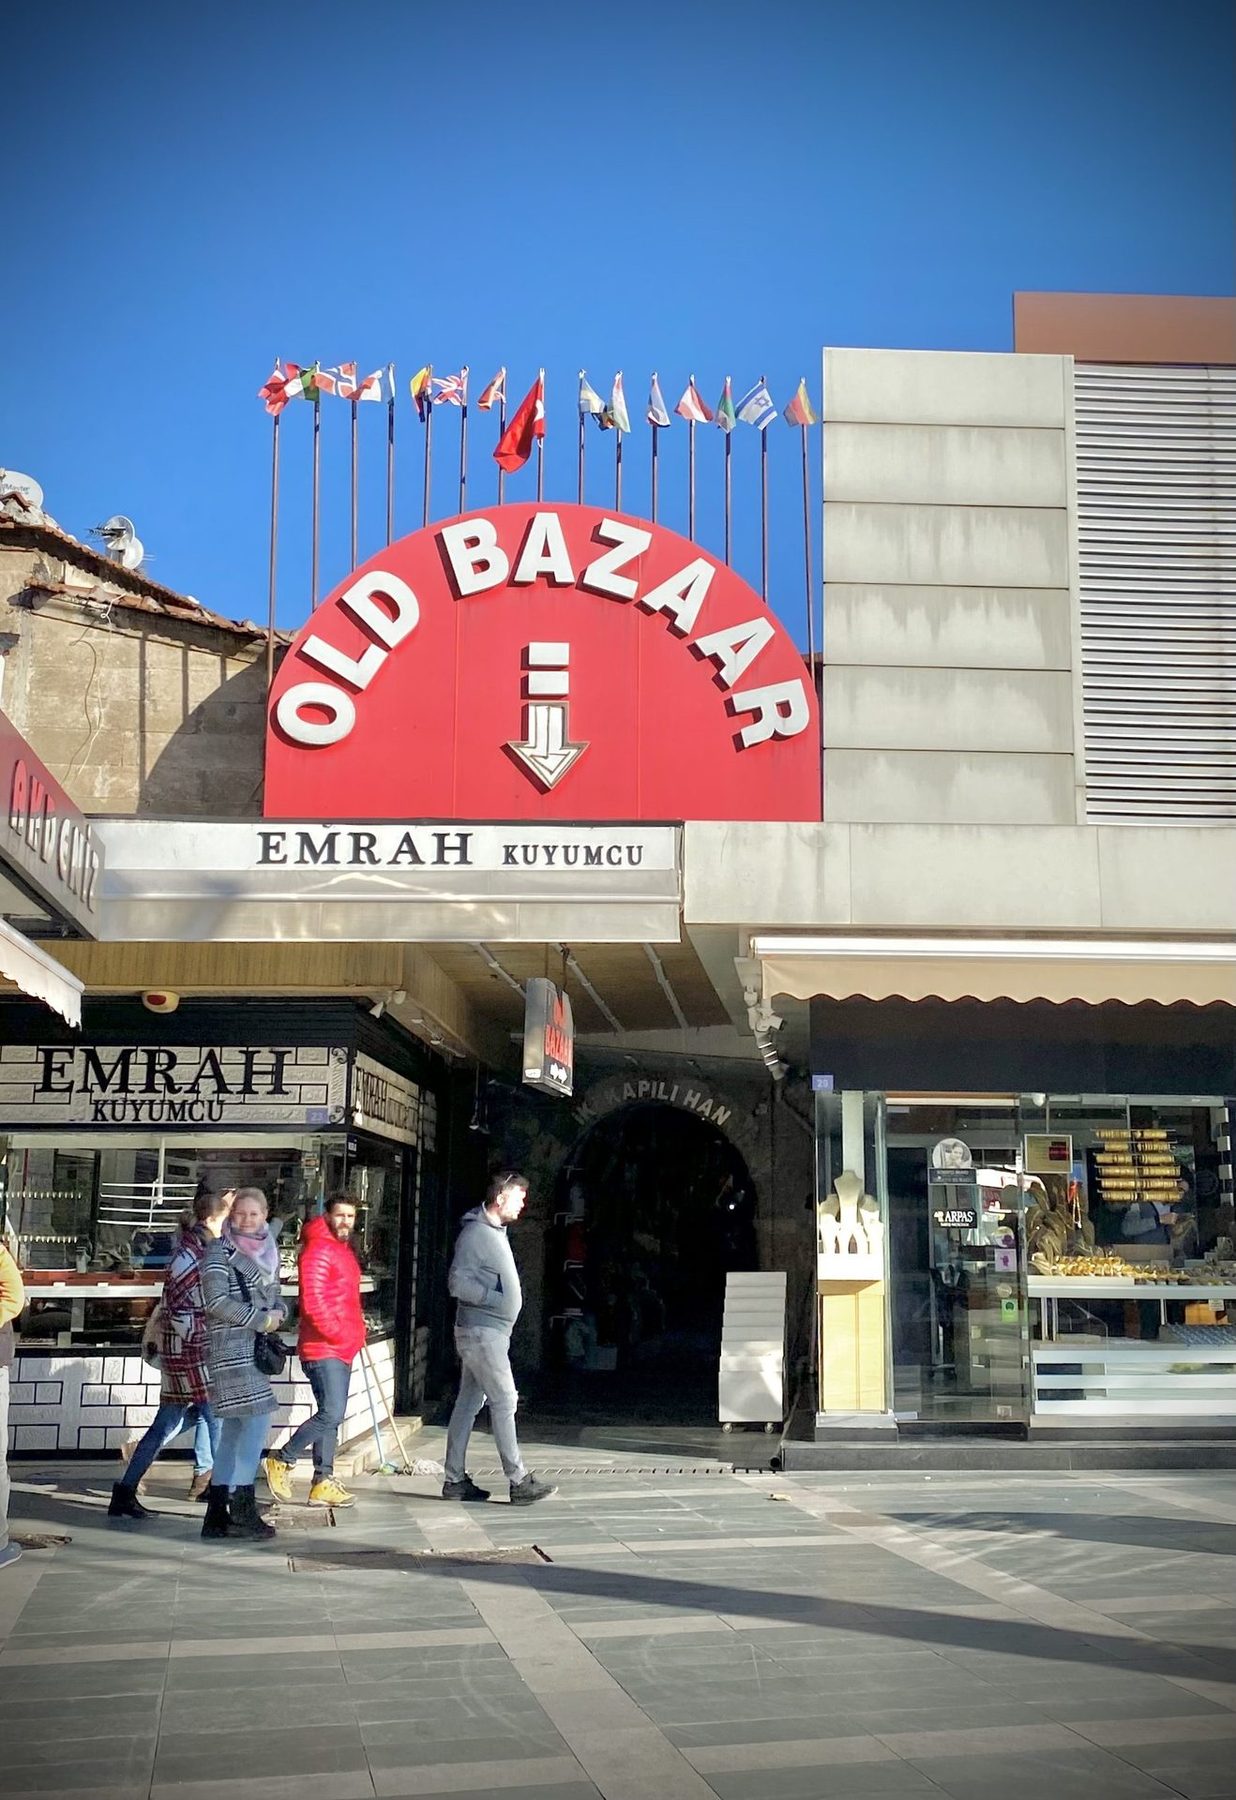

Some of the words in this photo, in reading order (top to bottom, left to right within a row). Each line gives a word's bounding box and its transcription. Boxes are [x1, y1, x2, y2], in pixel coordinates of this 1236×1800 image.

[275, 570, 421, 748] OLD
[436, 511, 811, 752] BAZAAR
[256, 831, 473, 866] EMRAH
[502, 844, 645, 867] KUYUMCU
[35, 1048, 293, 1095] EMRAH
[91, 1098, 225, 1123] KUYUMCU
[682, 1089, 733, 1127] HAN
[945, 1211, 973, 1223] ARPAS
